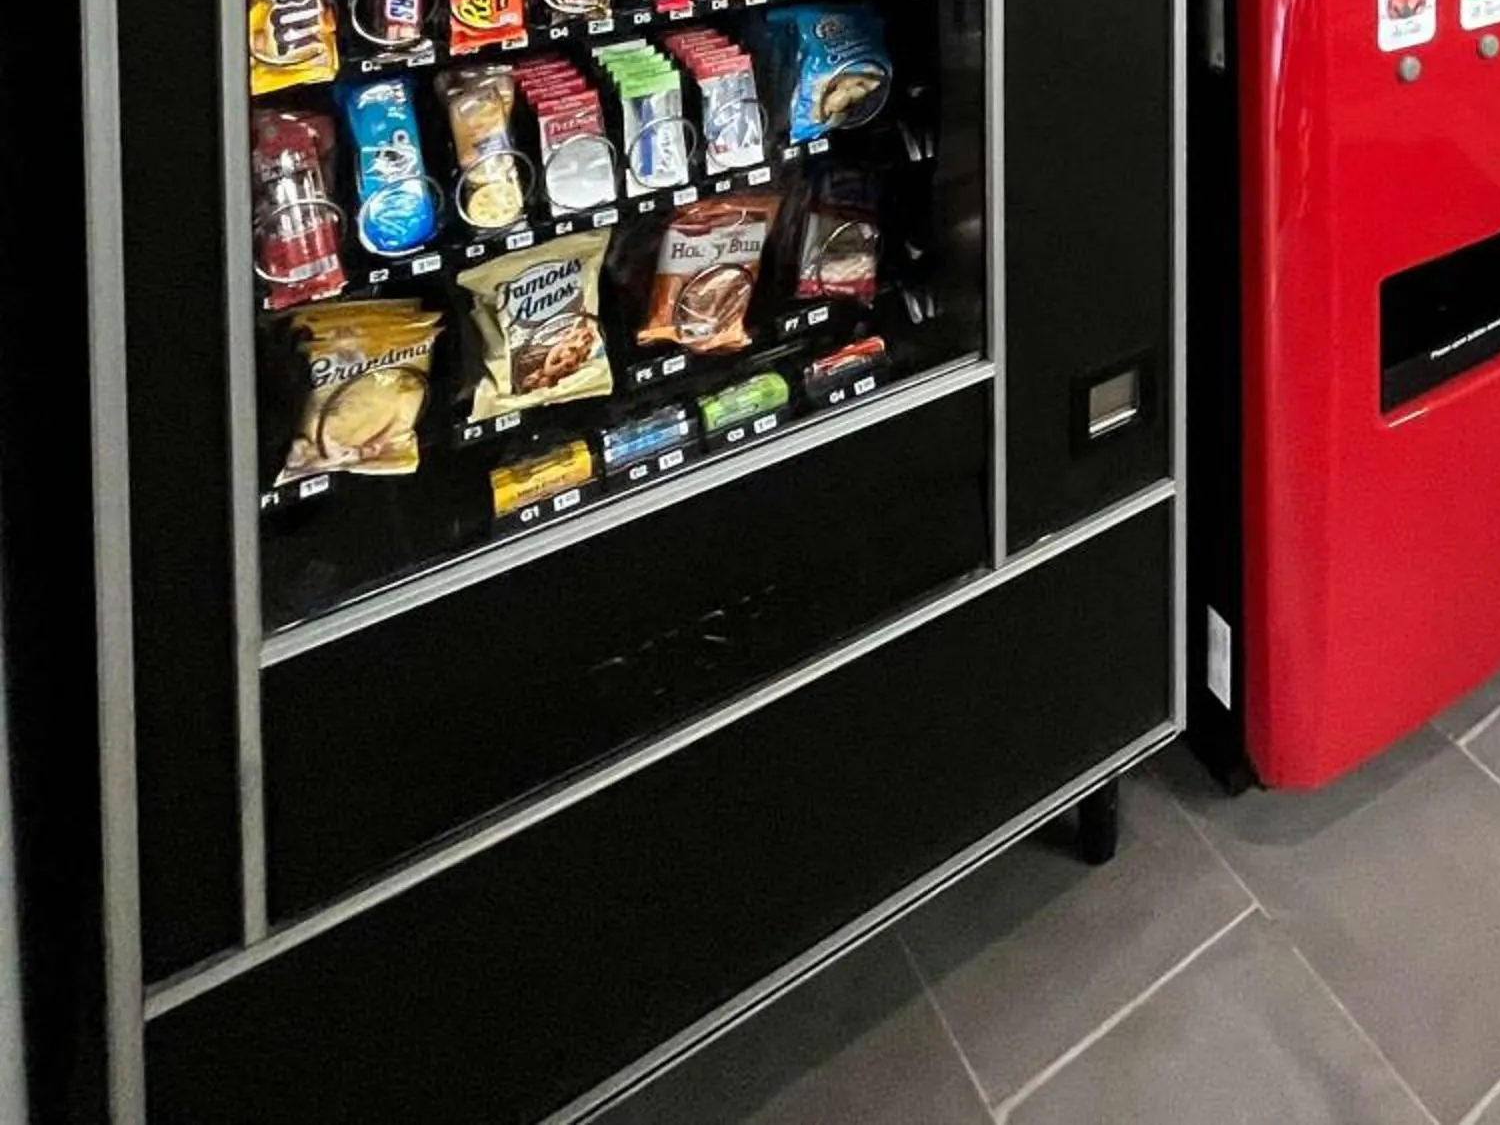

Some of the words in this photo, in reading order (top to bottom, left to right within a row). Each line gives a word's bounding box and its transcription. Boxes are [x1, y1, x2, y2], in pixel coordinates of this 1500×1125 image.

[550, 27, 570, 39] D4
[728, 238, 761, 255] Bun
[496, 258, 583, 310] Famous
[510, 280, 576, 325] Amos
[261, 493, 279, 509] F1
[520, 505, 539, 522] G1
